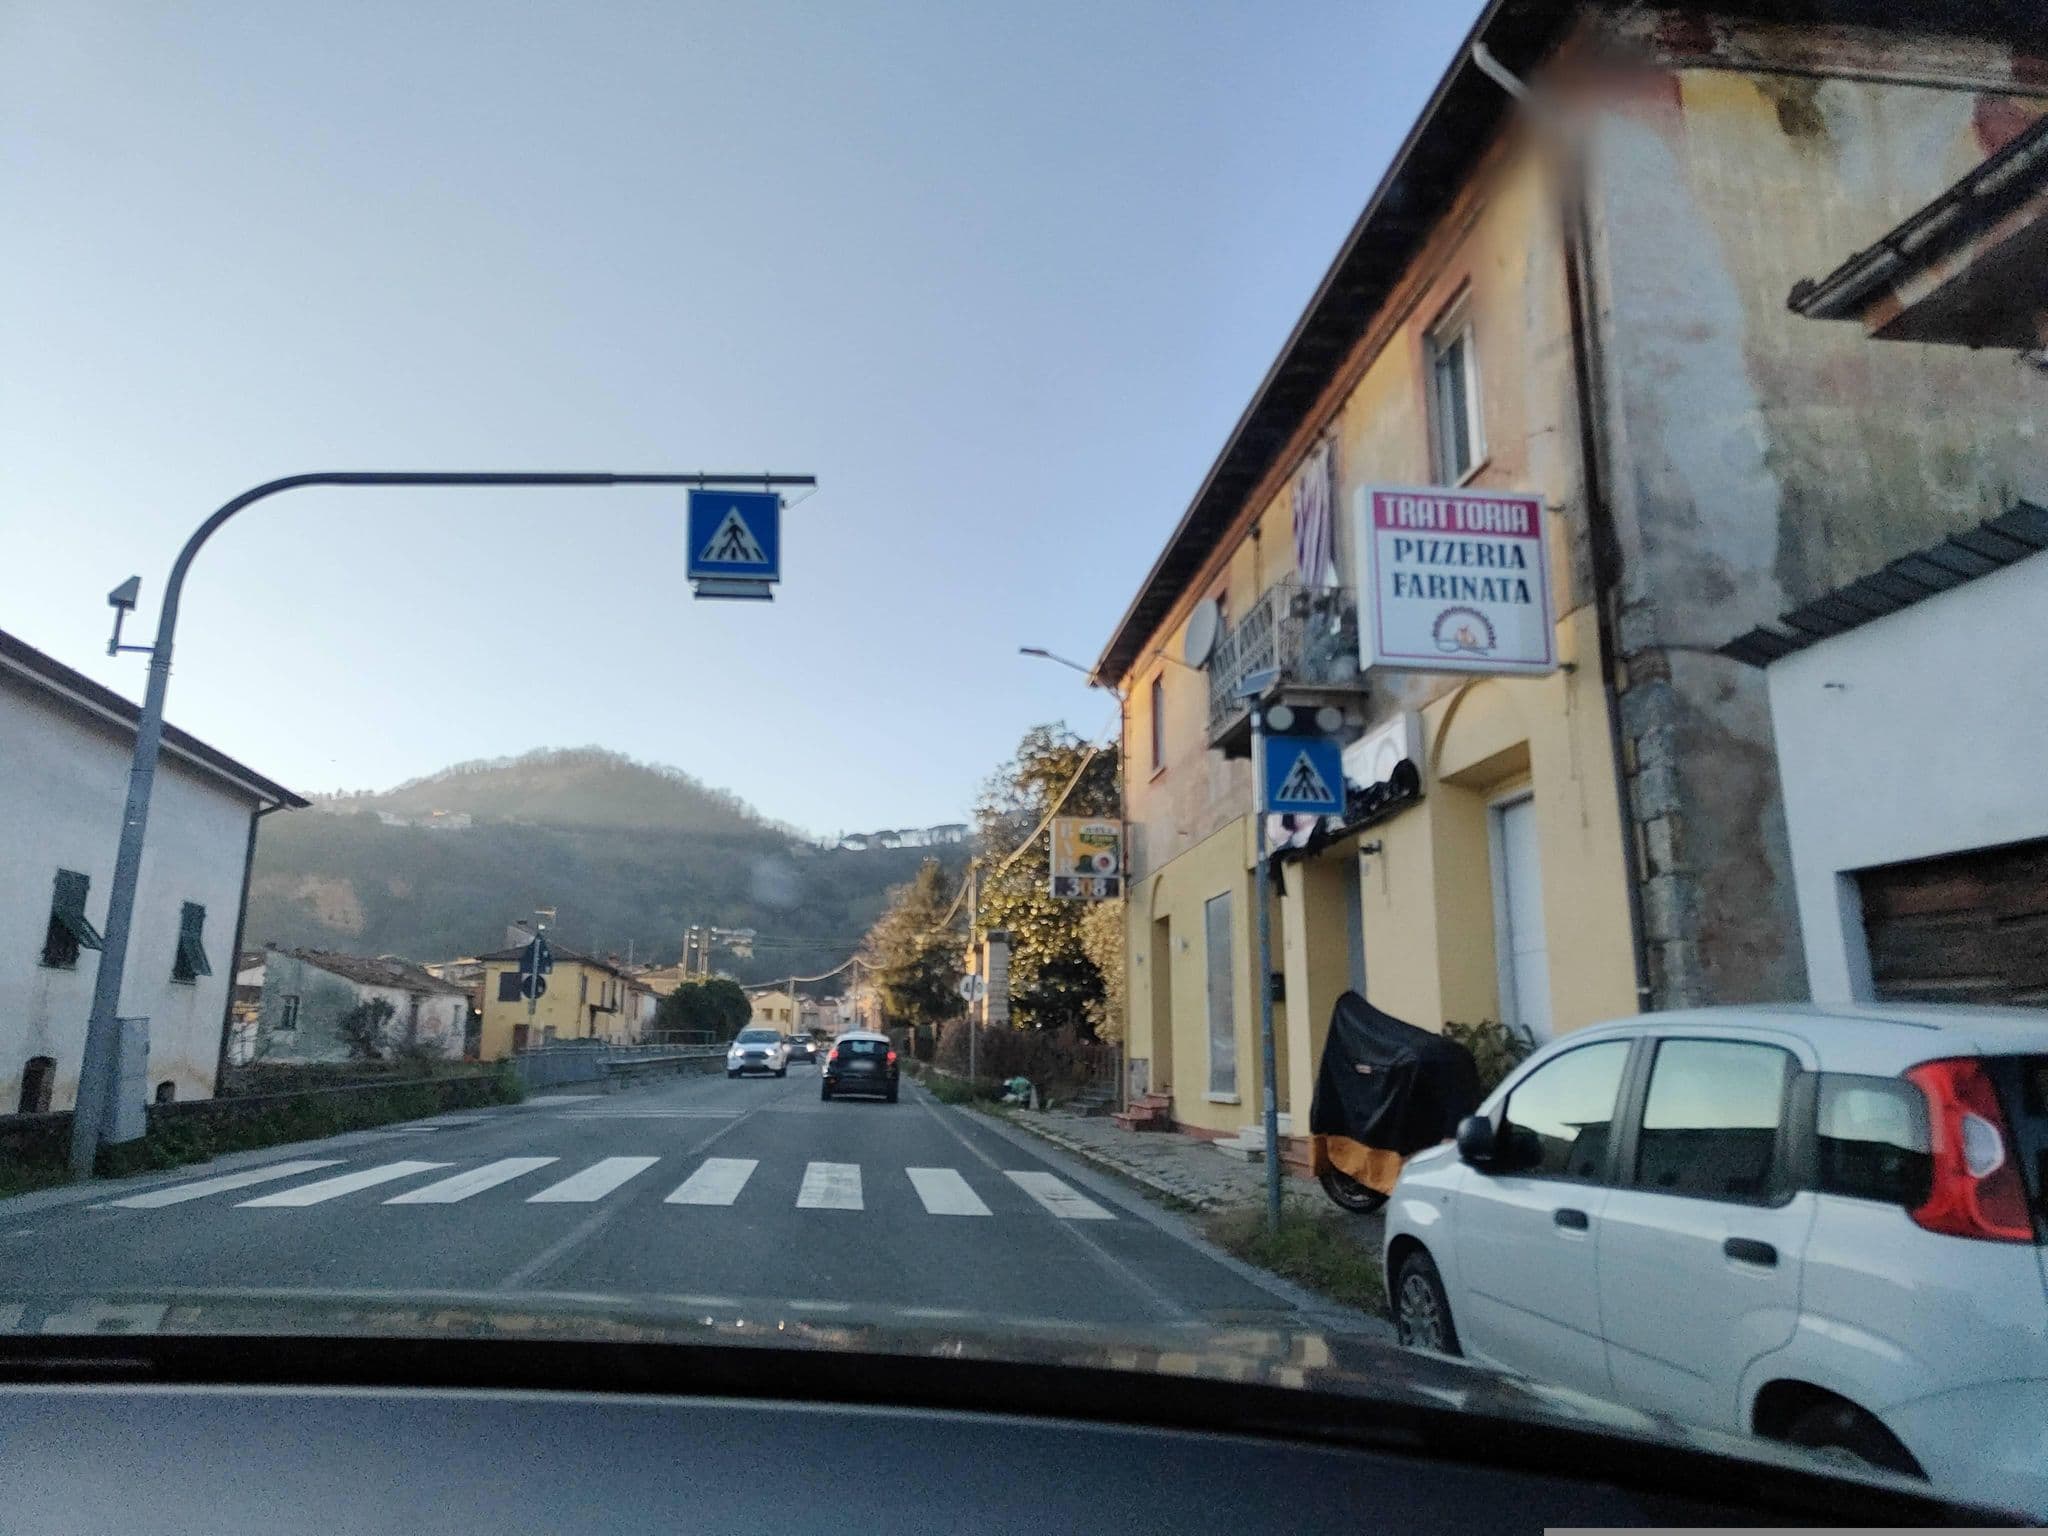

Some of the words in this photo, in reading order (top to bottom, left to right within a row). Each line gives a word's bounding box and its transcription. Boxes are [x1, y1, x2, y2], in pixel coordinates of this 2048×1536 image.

[1383, 498, 1528, 532] TRATTORIA
[1394, 538, 1527, 569] PIZZERIA
[1393, 572, 1531, 604] FARINATA
